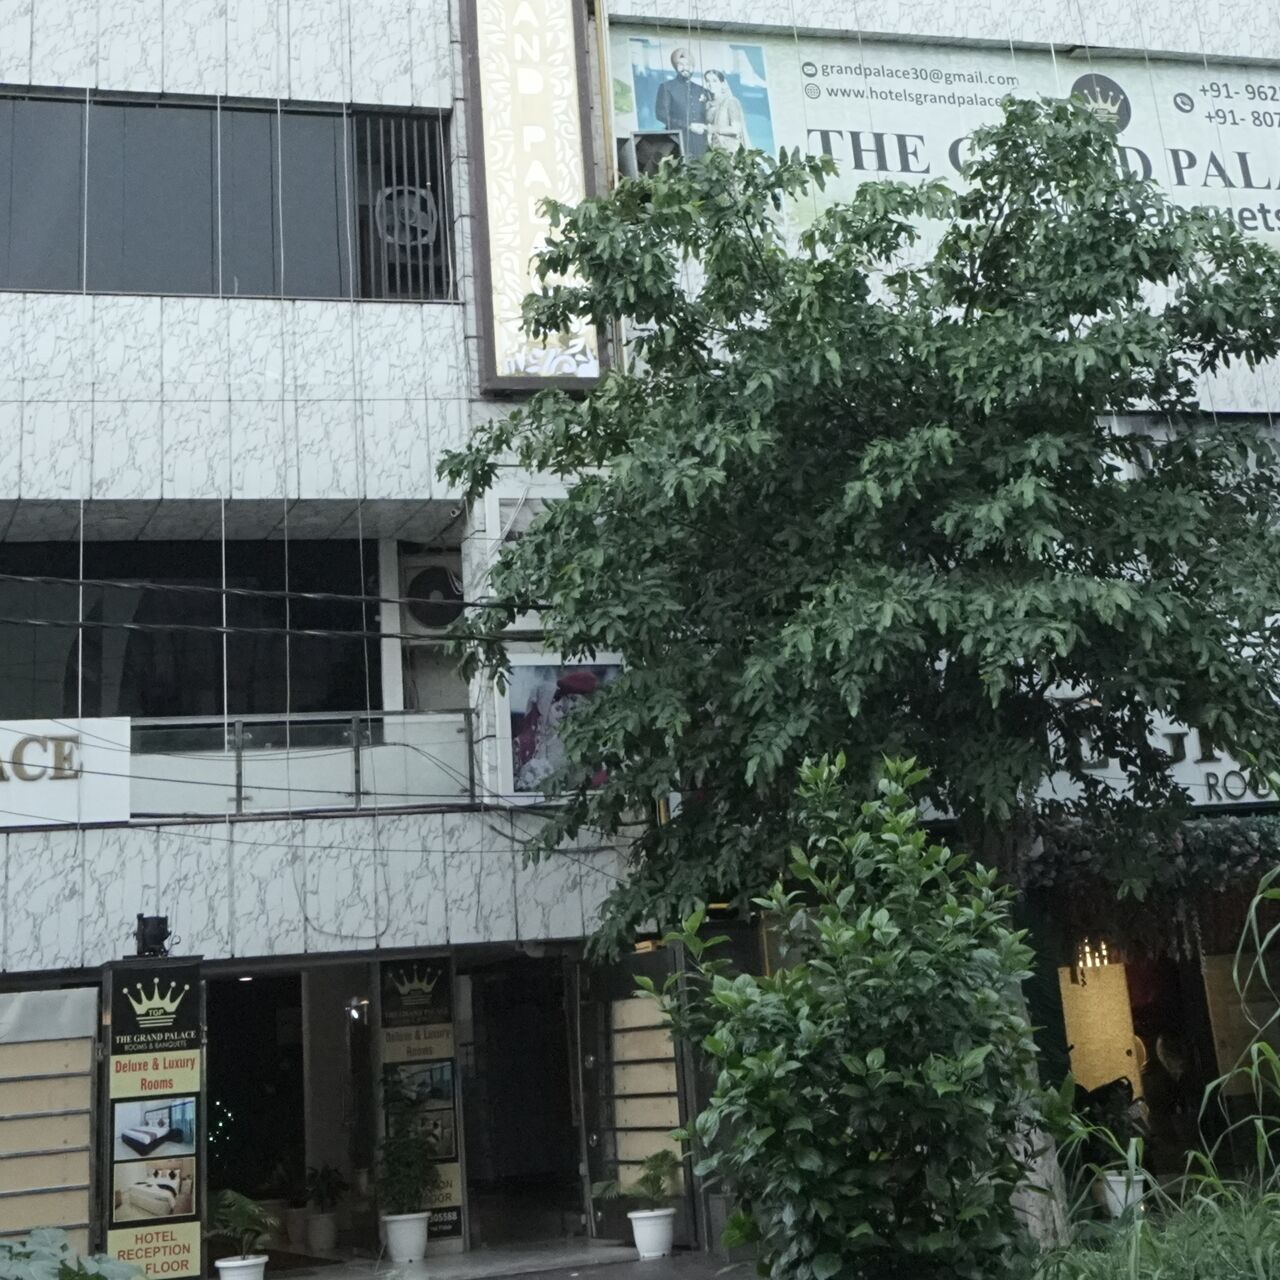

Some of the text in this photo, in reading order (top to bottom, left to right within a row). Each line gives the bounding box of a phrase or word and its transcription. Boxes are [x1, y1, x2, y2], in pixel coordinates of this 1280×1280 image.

[821, 61, 1019, 87] grandpalace30@gmail.com
[807, 128, 930, 174] THE
[116, 1031, 196, 1044] THE GRAND PALACE
[115, 1057, 195, 1073] Deluxe & Luxury
[140, 1078, 174, 1091] Rooms
[135, 1230, 177, 1245] HOTEL
[117, 1243, 191, 1261] RECEPTION
[145, 1259, 189, 1275] FLOOR
